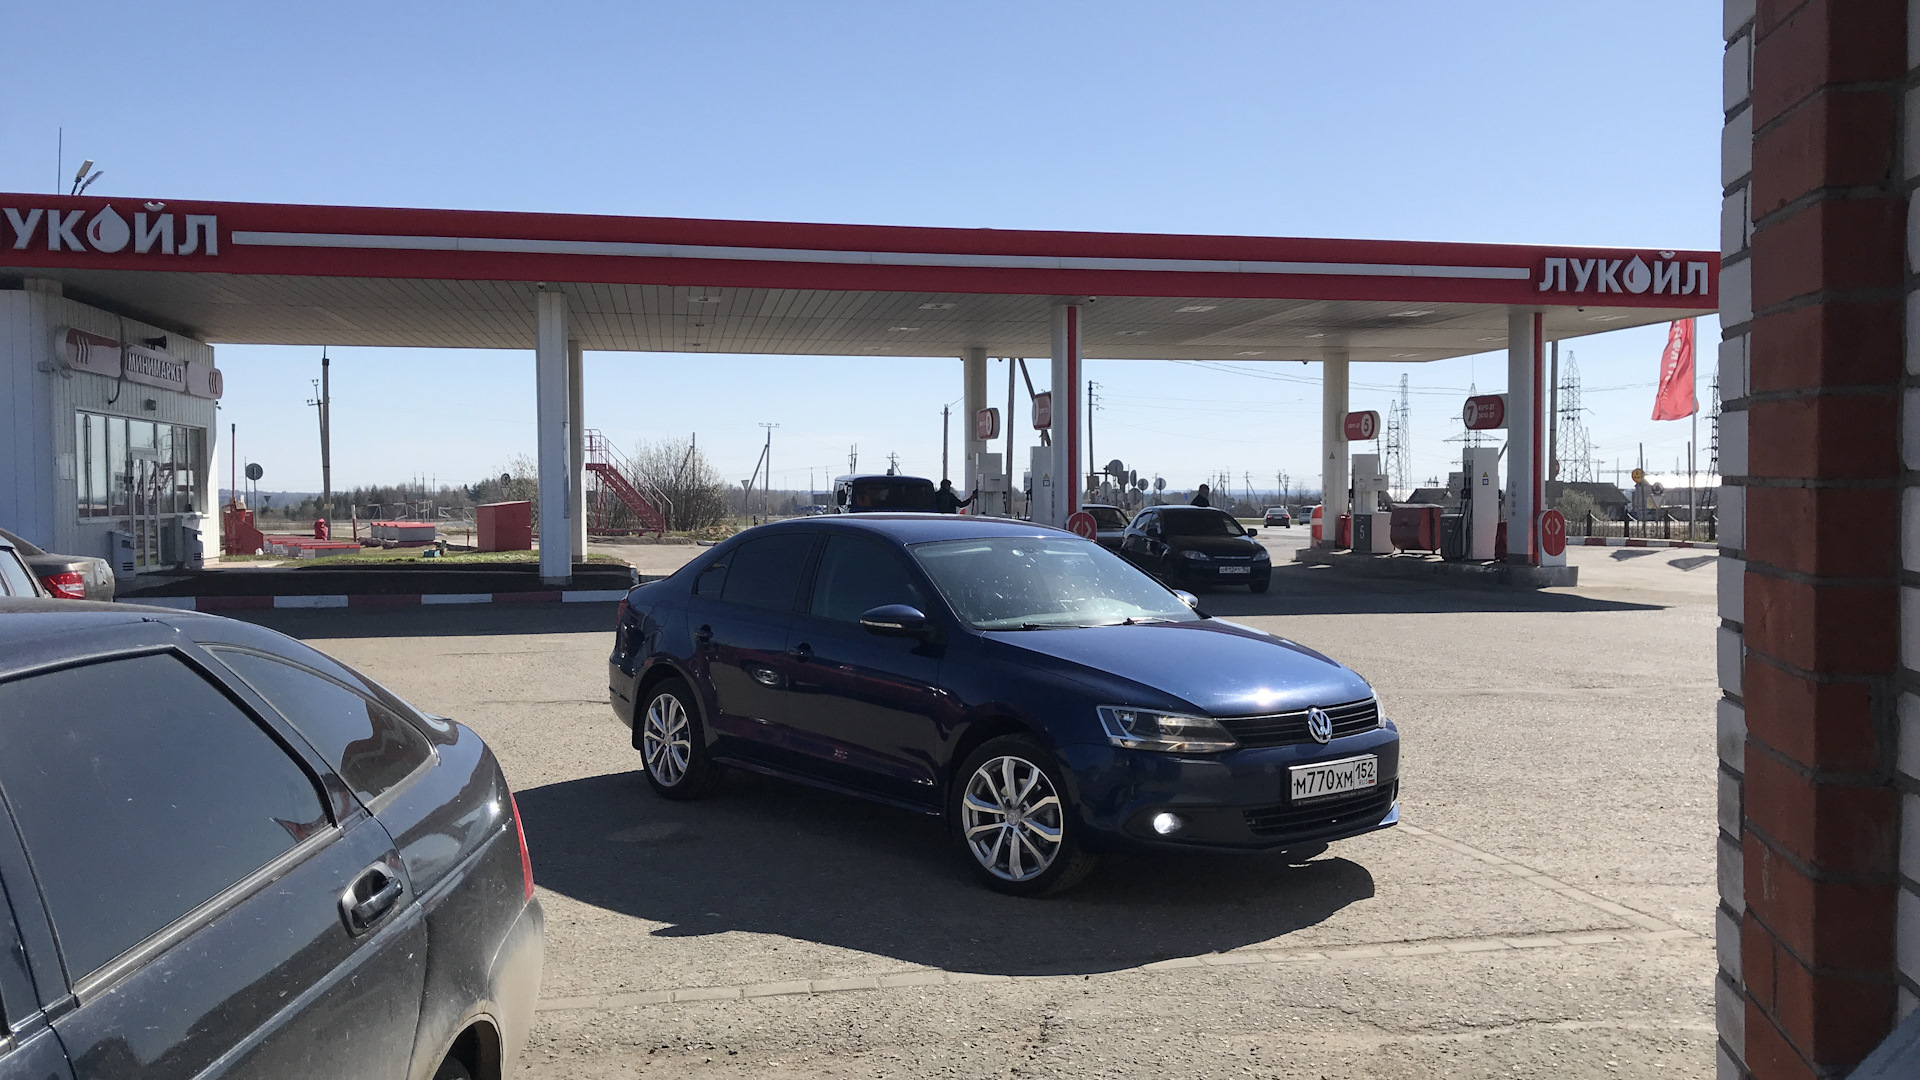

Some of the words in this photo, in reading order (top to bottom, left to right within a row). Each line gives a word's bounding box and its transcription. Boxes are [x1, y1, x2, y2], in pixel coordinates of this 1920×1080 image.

[1539, 251, 1708, 295] ЛУКОЙЛ
[127, 353, 184, 382] МИНИМАРКЕТ
[1467, 405, 1475, 422] 7
[1363, 418, 1370, 432] 5
[1355, 761, 1374, 780] 152
